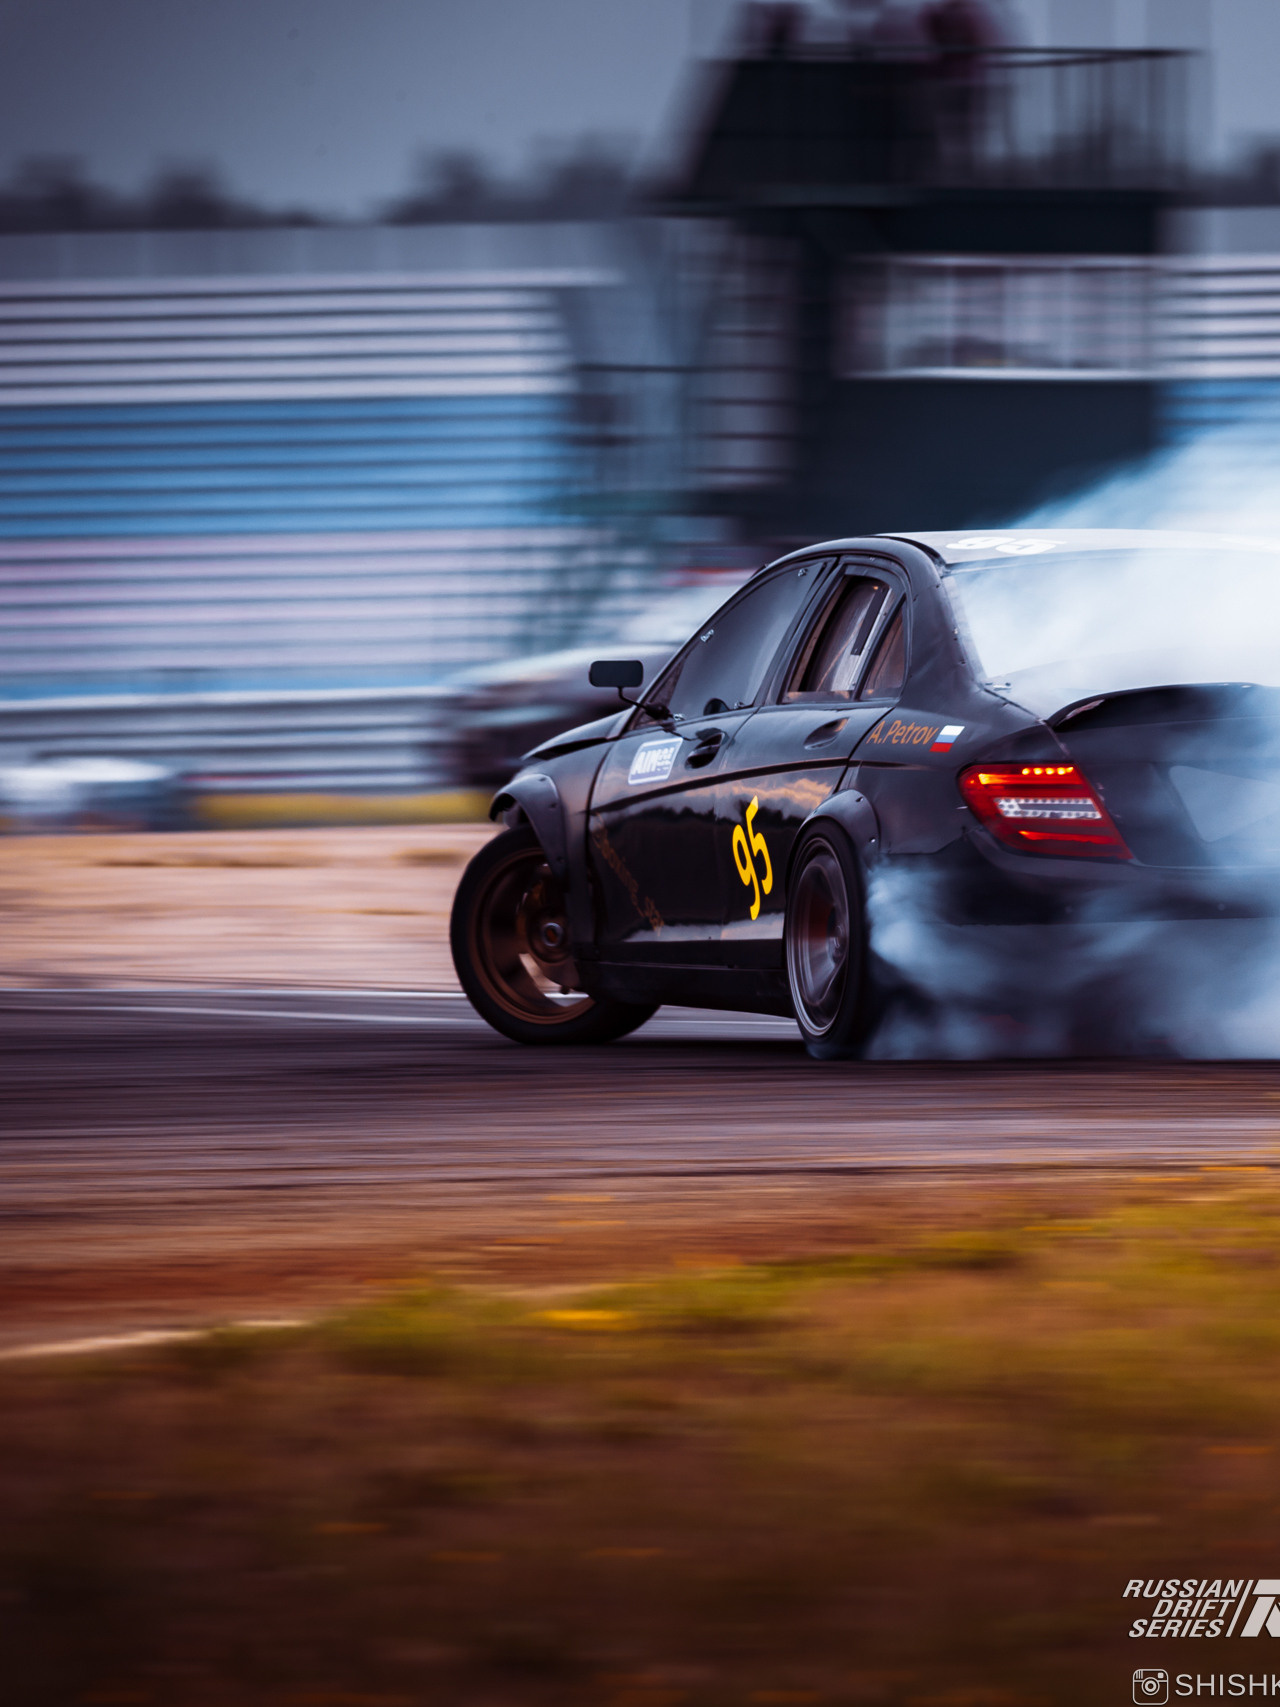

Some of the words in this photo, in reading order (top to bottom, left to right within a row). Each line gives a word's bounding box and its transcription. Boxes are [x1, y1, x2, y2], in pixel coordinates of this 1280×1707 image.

[945, 536, 1067, 555] 95
[865, 720, 939, 745] A.Petrov
[732, 795, 773, 921] 95
